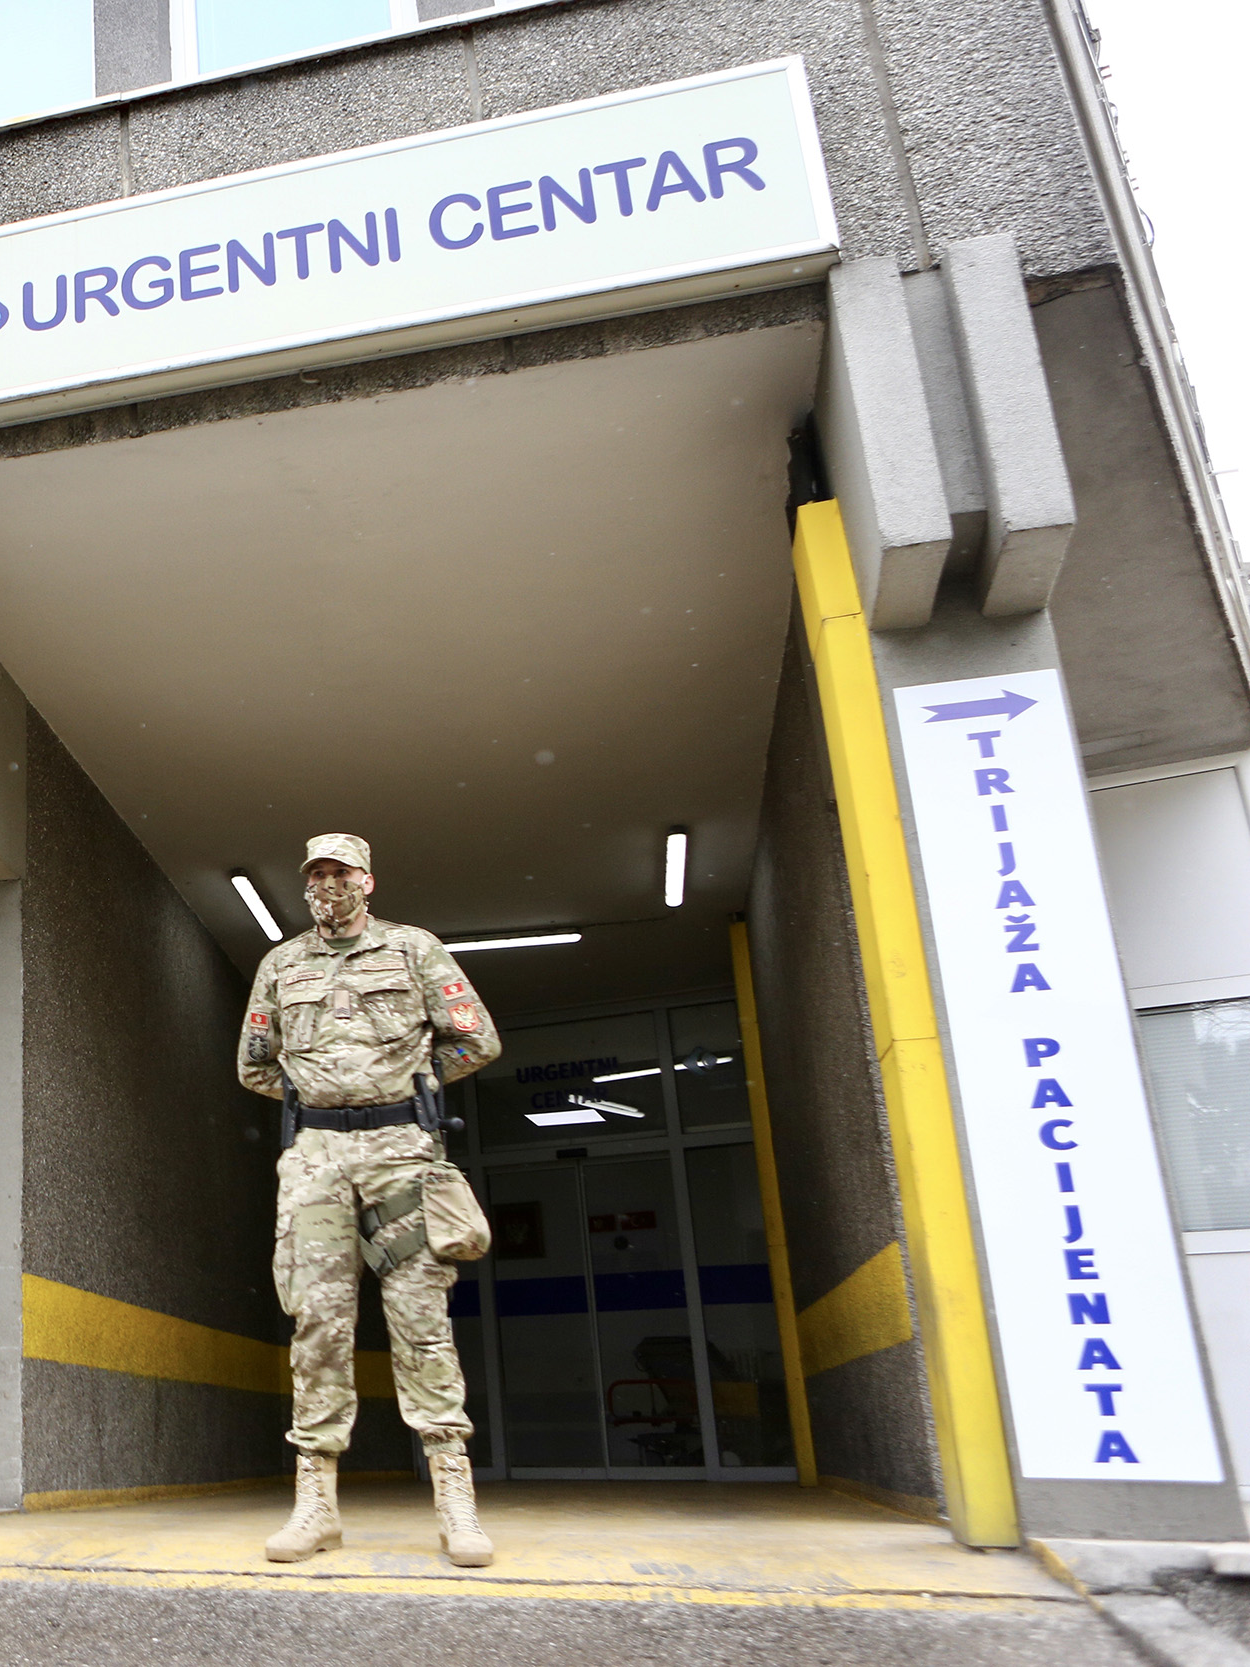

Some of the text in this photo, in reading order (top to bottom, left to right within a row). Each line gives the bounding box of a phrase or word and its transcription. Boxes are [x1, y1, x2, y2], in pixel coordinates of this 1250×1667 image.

[22, 138, 765, 331] URGENTNI CENTAR
[516, 1056, 618, 1083] URGENTNI
[967, 730, 1139, 1464] TRIJAŽA PACIJENATA
